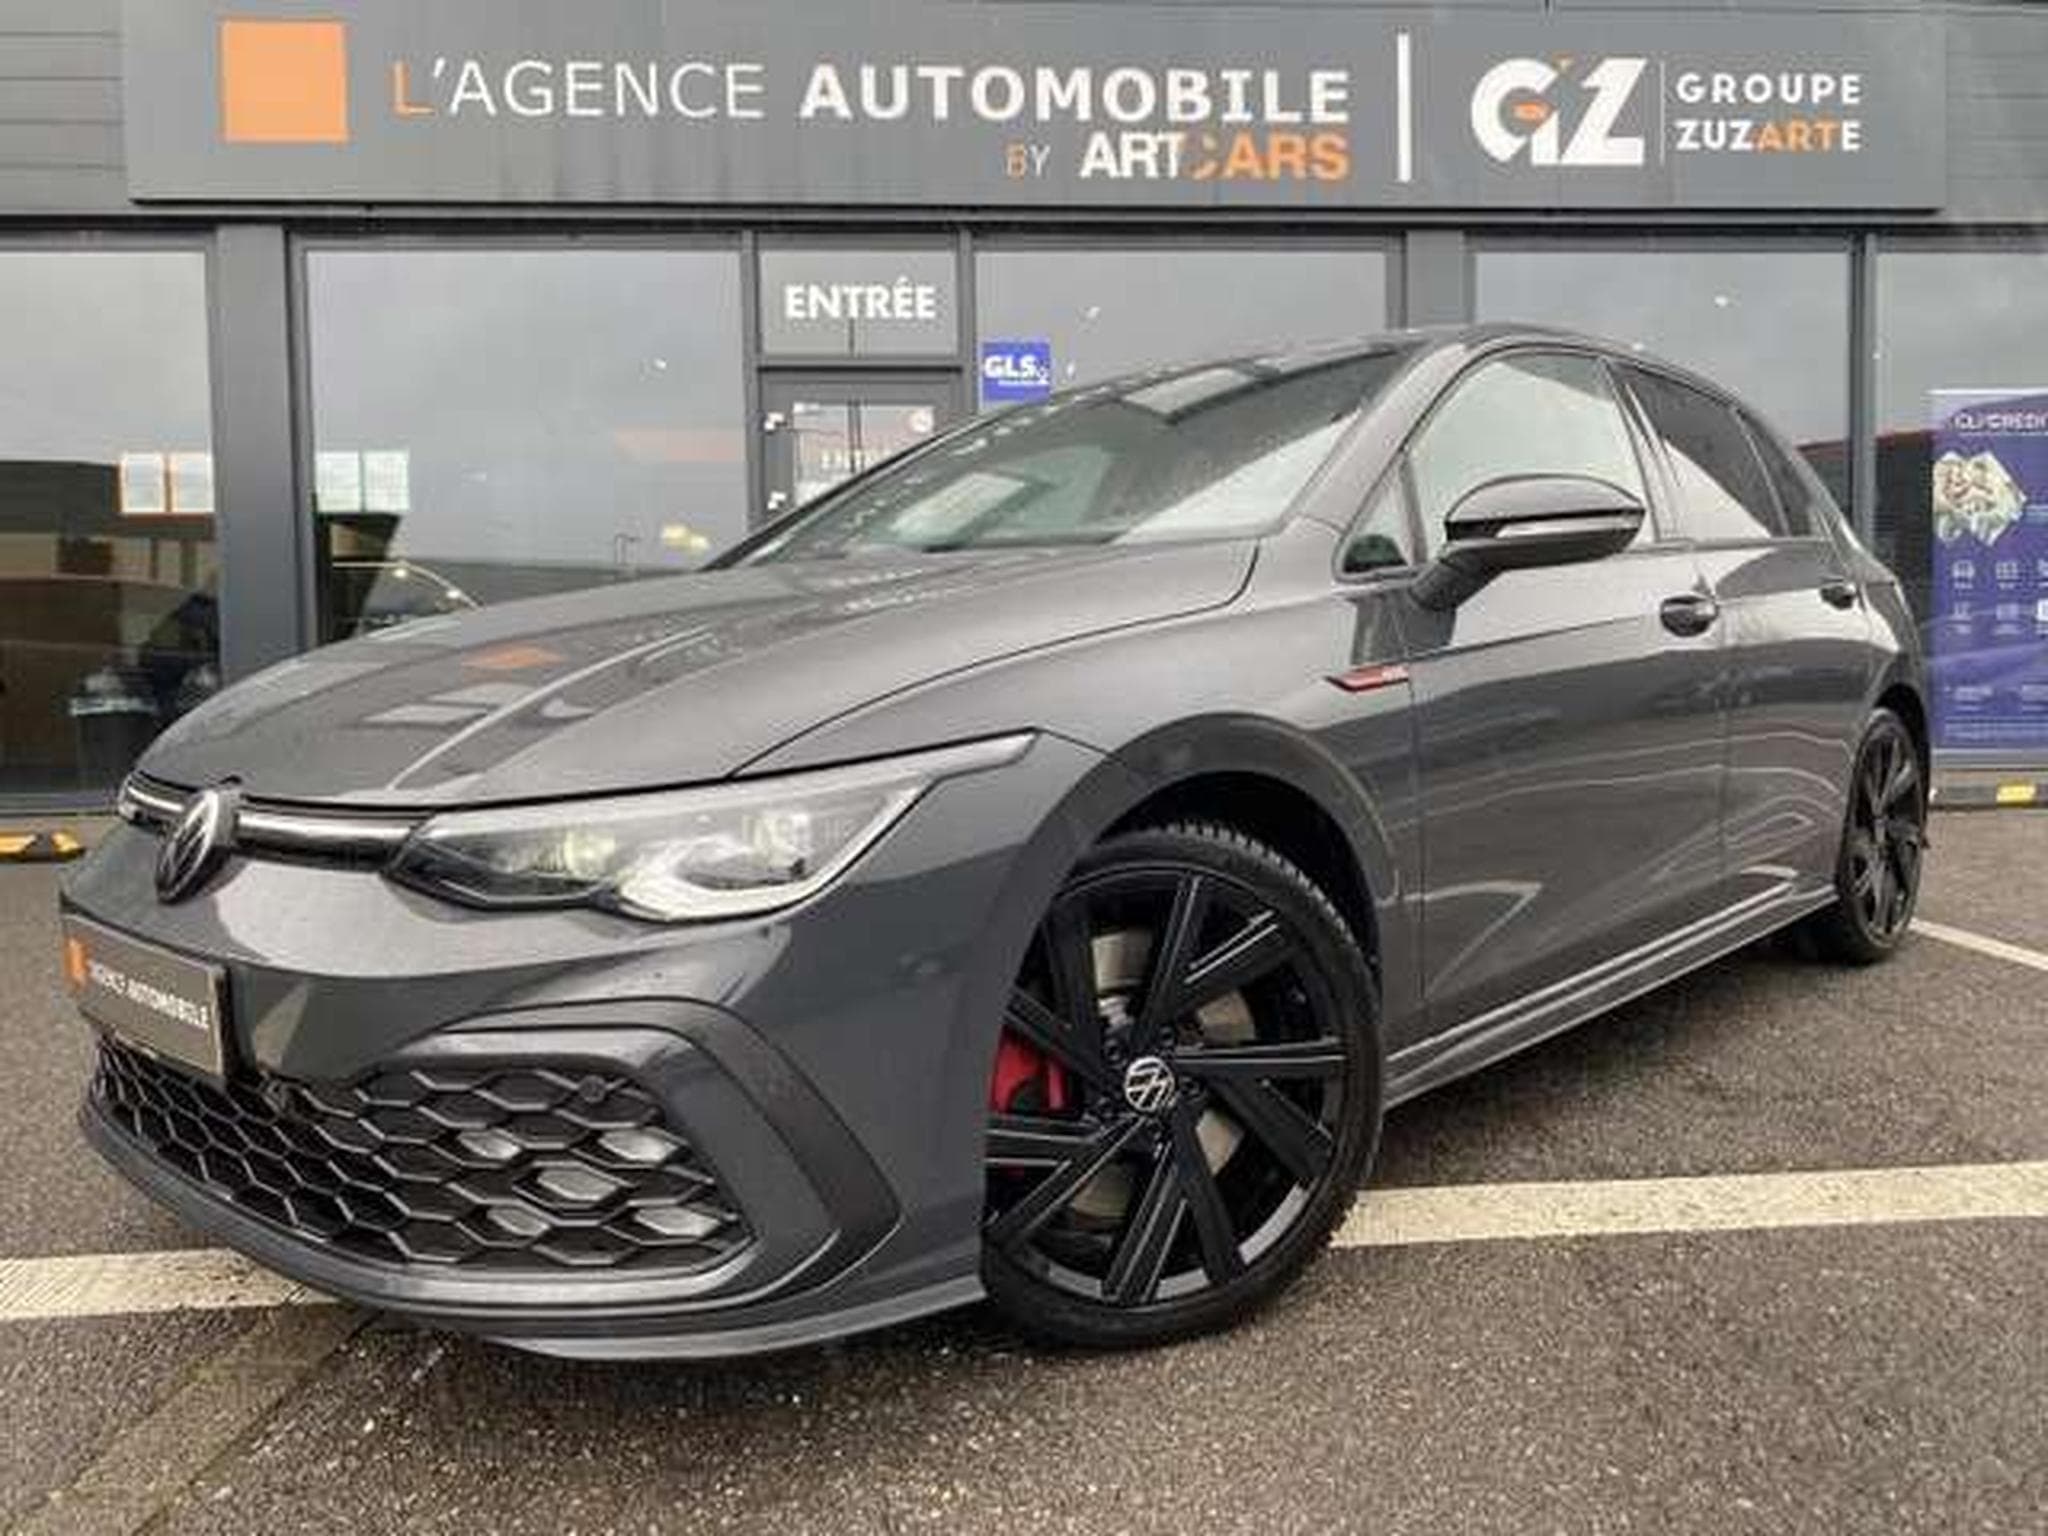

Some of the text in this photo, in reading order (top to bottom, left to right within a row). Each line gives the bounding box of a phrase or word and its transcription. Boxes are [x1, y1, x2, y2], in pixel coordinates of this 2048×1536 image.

[391, 56, 1350, 123] L'AGENCE AUTOMOBILE
[1675, 71, 1861, 106] GROUPE
[1675, 118, 1862, 152] ZUZARTE
[1006, 144, 1051, 180] BY
[784, 275, 937, 320] ENTRÉE
